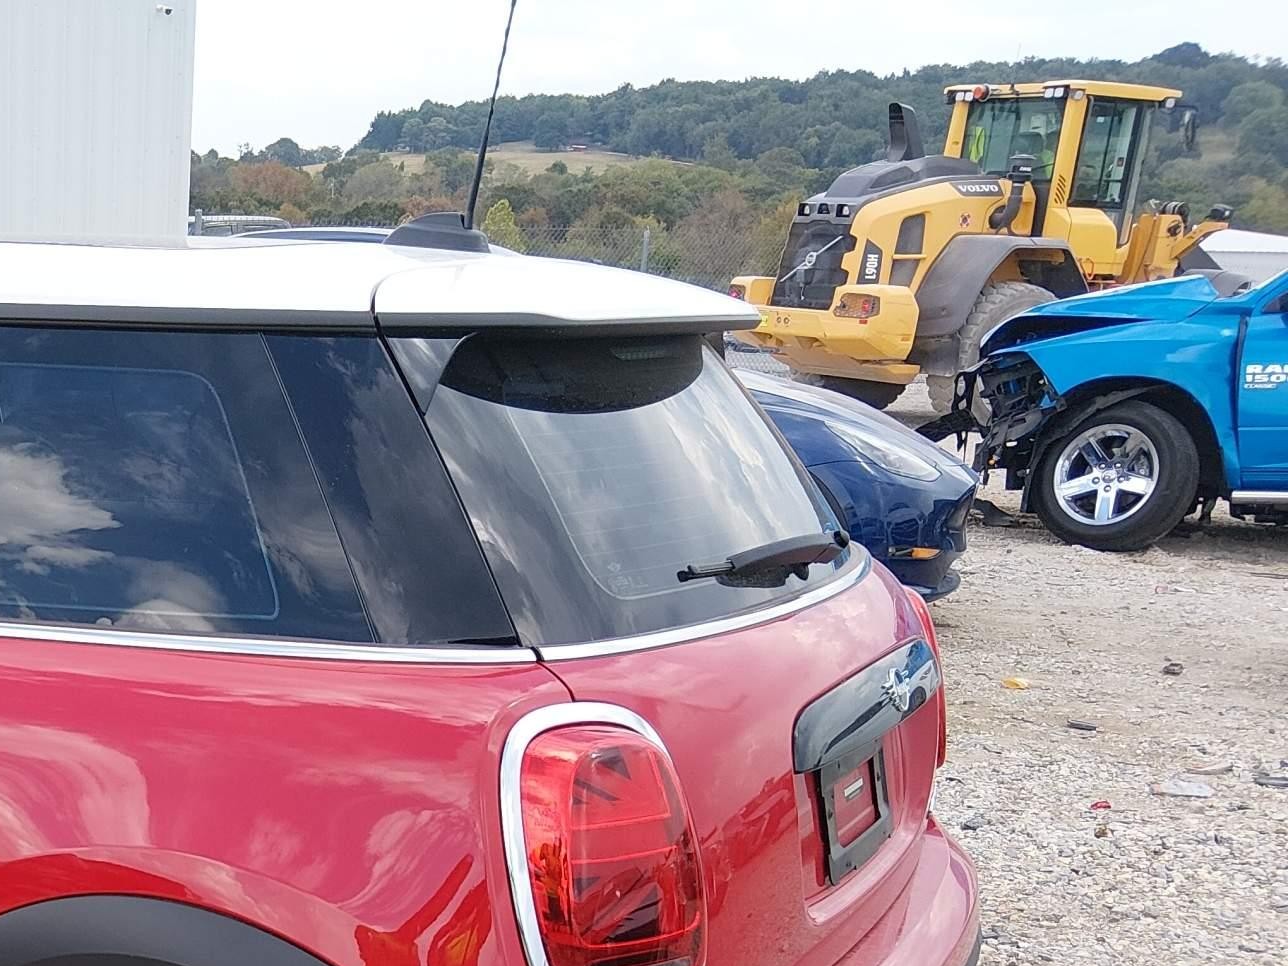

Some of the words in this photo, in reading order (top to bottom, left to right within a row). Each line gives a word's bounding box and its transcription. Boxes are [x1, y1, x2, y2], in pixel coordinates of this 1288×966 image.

[957, 184, 999, 193] VOLVO
[864, 253, 879, 280] L90H
[1245, 374, 1288, 383] 150
